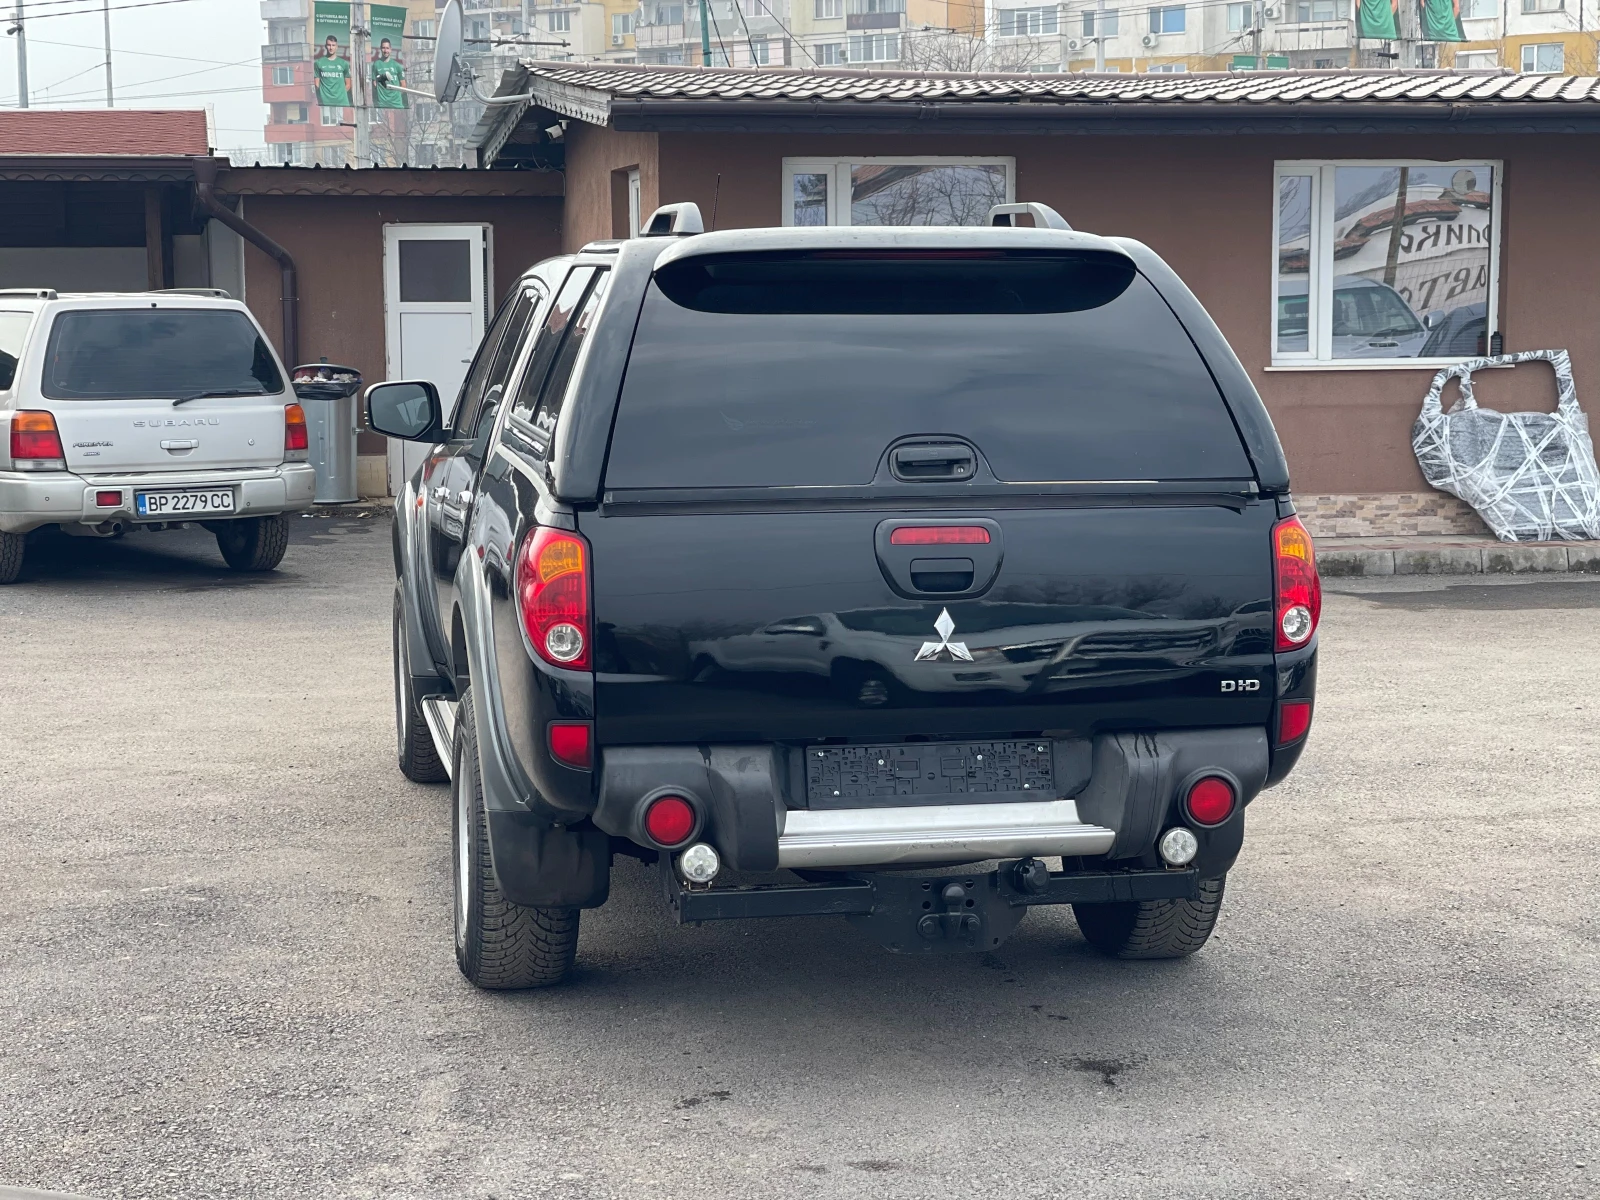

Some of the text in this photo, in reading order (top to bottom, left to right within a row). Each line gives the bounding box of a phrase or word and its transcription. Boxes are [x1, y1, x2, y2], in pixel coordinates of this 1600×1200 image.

[133, 418, 220, 428] SUBARU
[148, 493, 231, 512] BP 2279 CC
